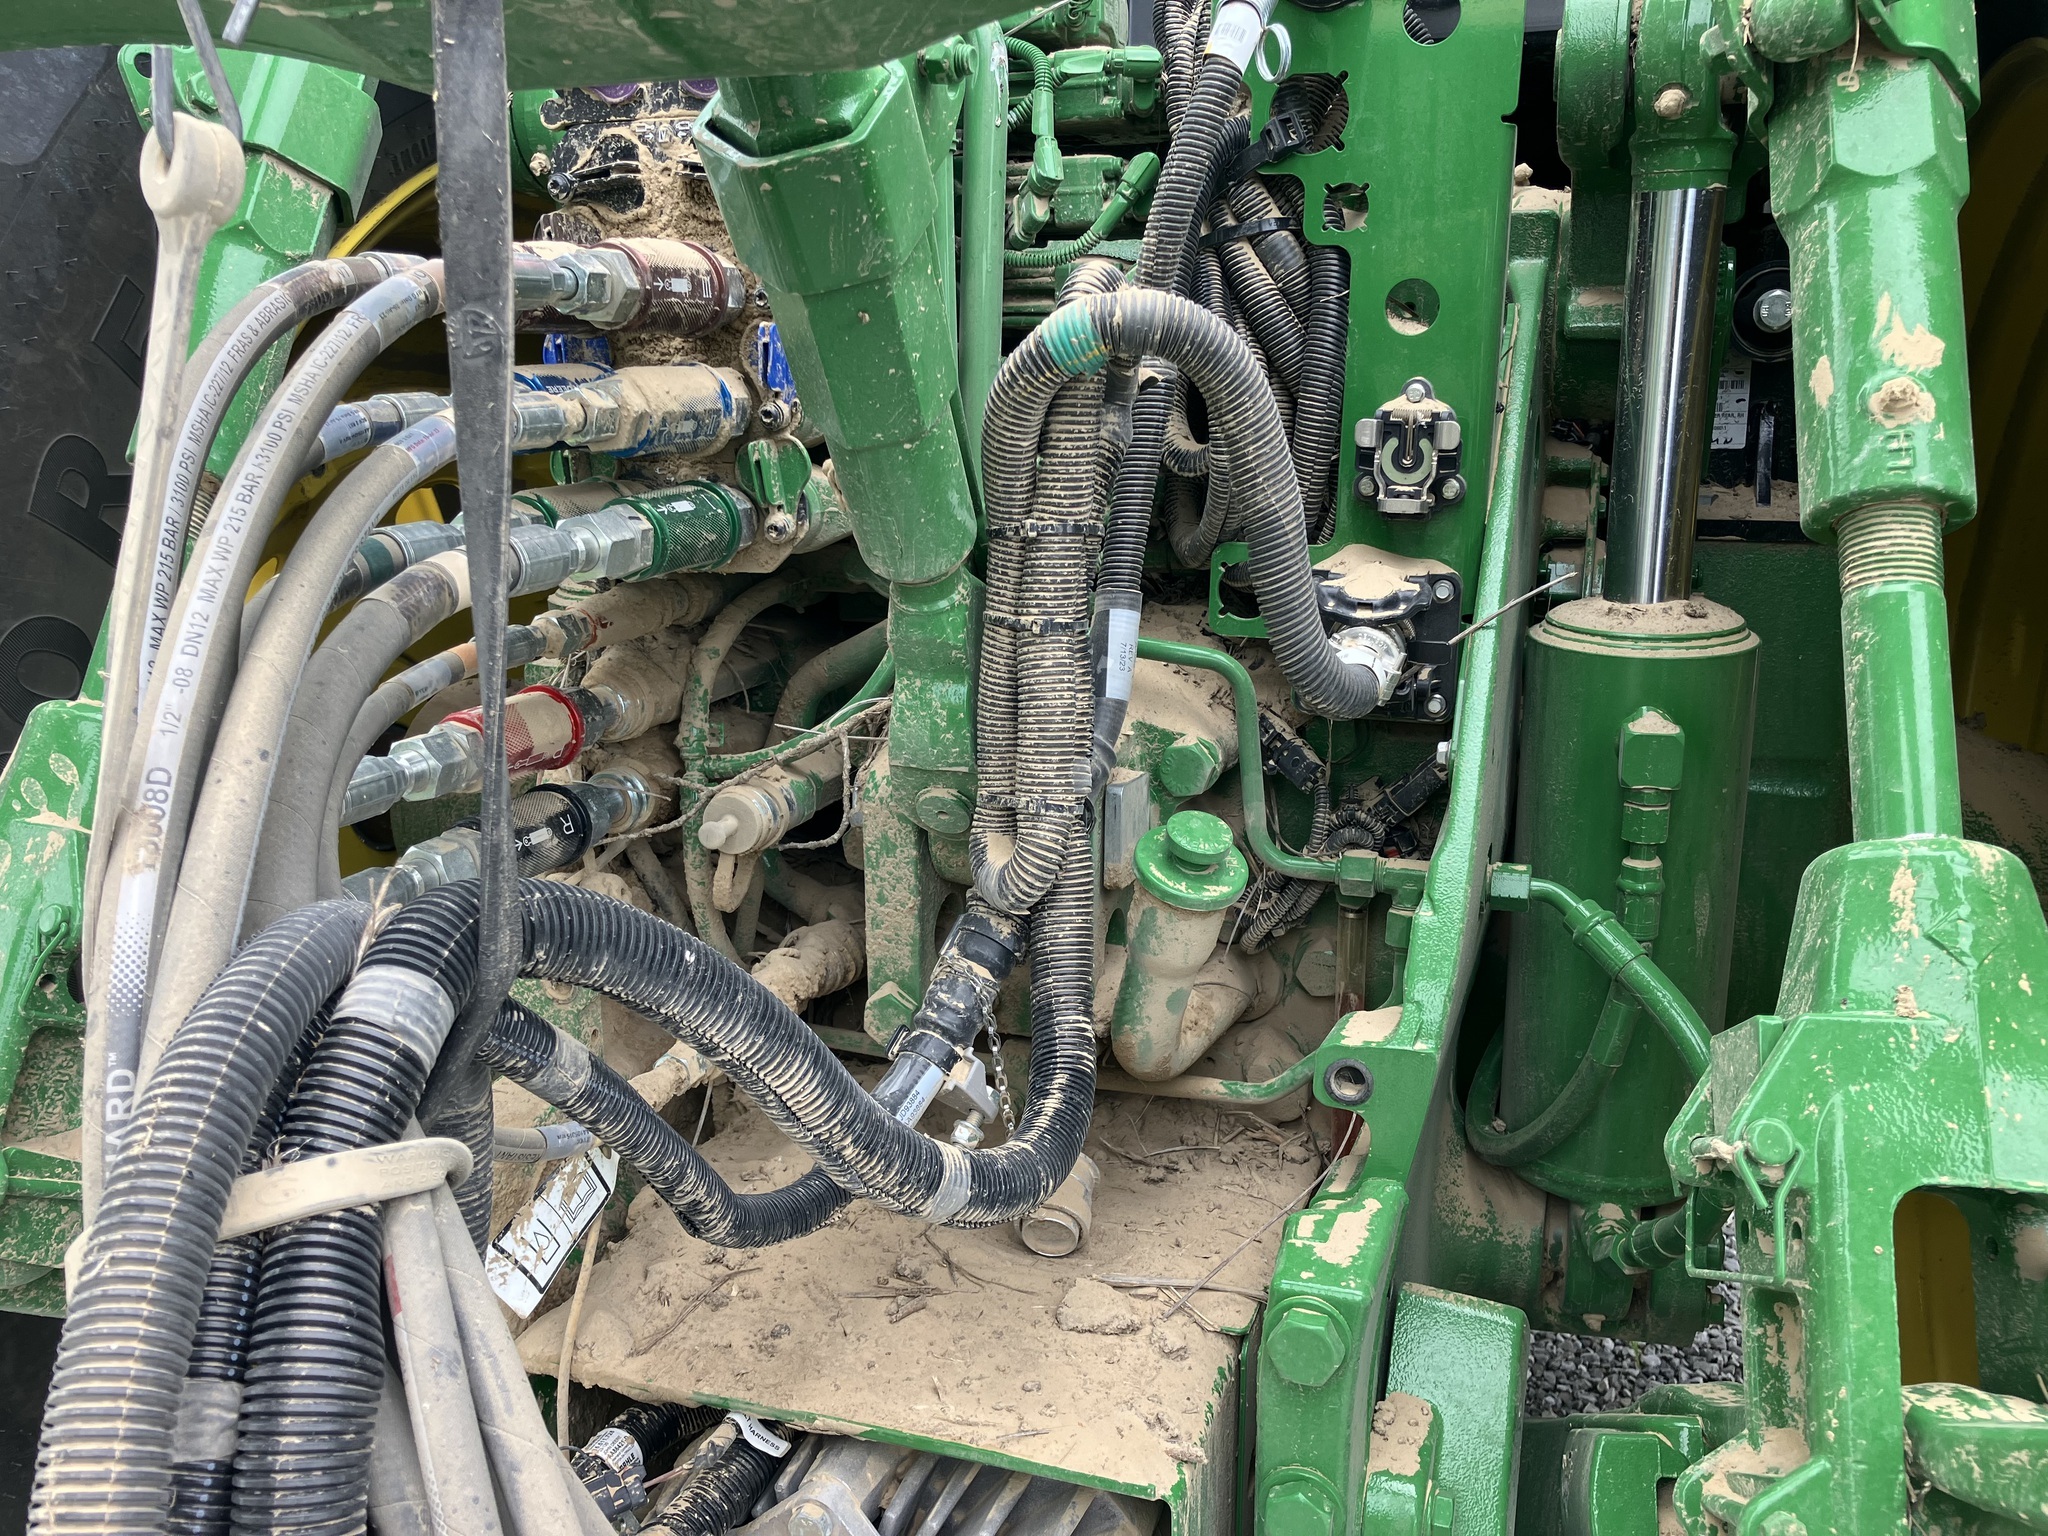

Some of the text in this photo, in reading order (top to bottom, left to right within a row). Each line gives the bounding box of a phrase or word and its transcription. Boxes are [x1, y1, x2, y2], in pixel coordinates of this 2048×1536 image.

[251, 321, 261, 338] &
[351, 312, 370, 333] FR
[227, 329, 254, 365] FRAS
[312, 328, 354, 372] IC-227/12
[203, 361, 234, 405] IC-227/12
[288, 369, 319, 406] MSHA
[187, 407, 213, 446] MSHA
[273, 408, 297, 438] PSI
[179, 449, 198, 477] PSI
[256, 432, 283, 465] 3100
[171, 474, 190, 509] 3100
[236, 471, 264, 506] BAR
[161, 518, 180, 552] BAR
[225, 506, 247, 534] 215
[211, 535, 235, 566] WP
[158, 553, 176, 582] 215
[155, 582, 170, 611] WP
[197, 564, 227, 605] MAX
[149, 612, 168, 651] MAX
[180, 611, 211, 658] DN12
[171, 666, 194, 695] -08
[161, 702, 182, 737] 1/2"
[560, 813, 575, 835] R
[747, 1422, 780, 1451] HARNESS
